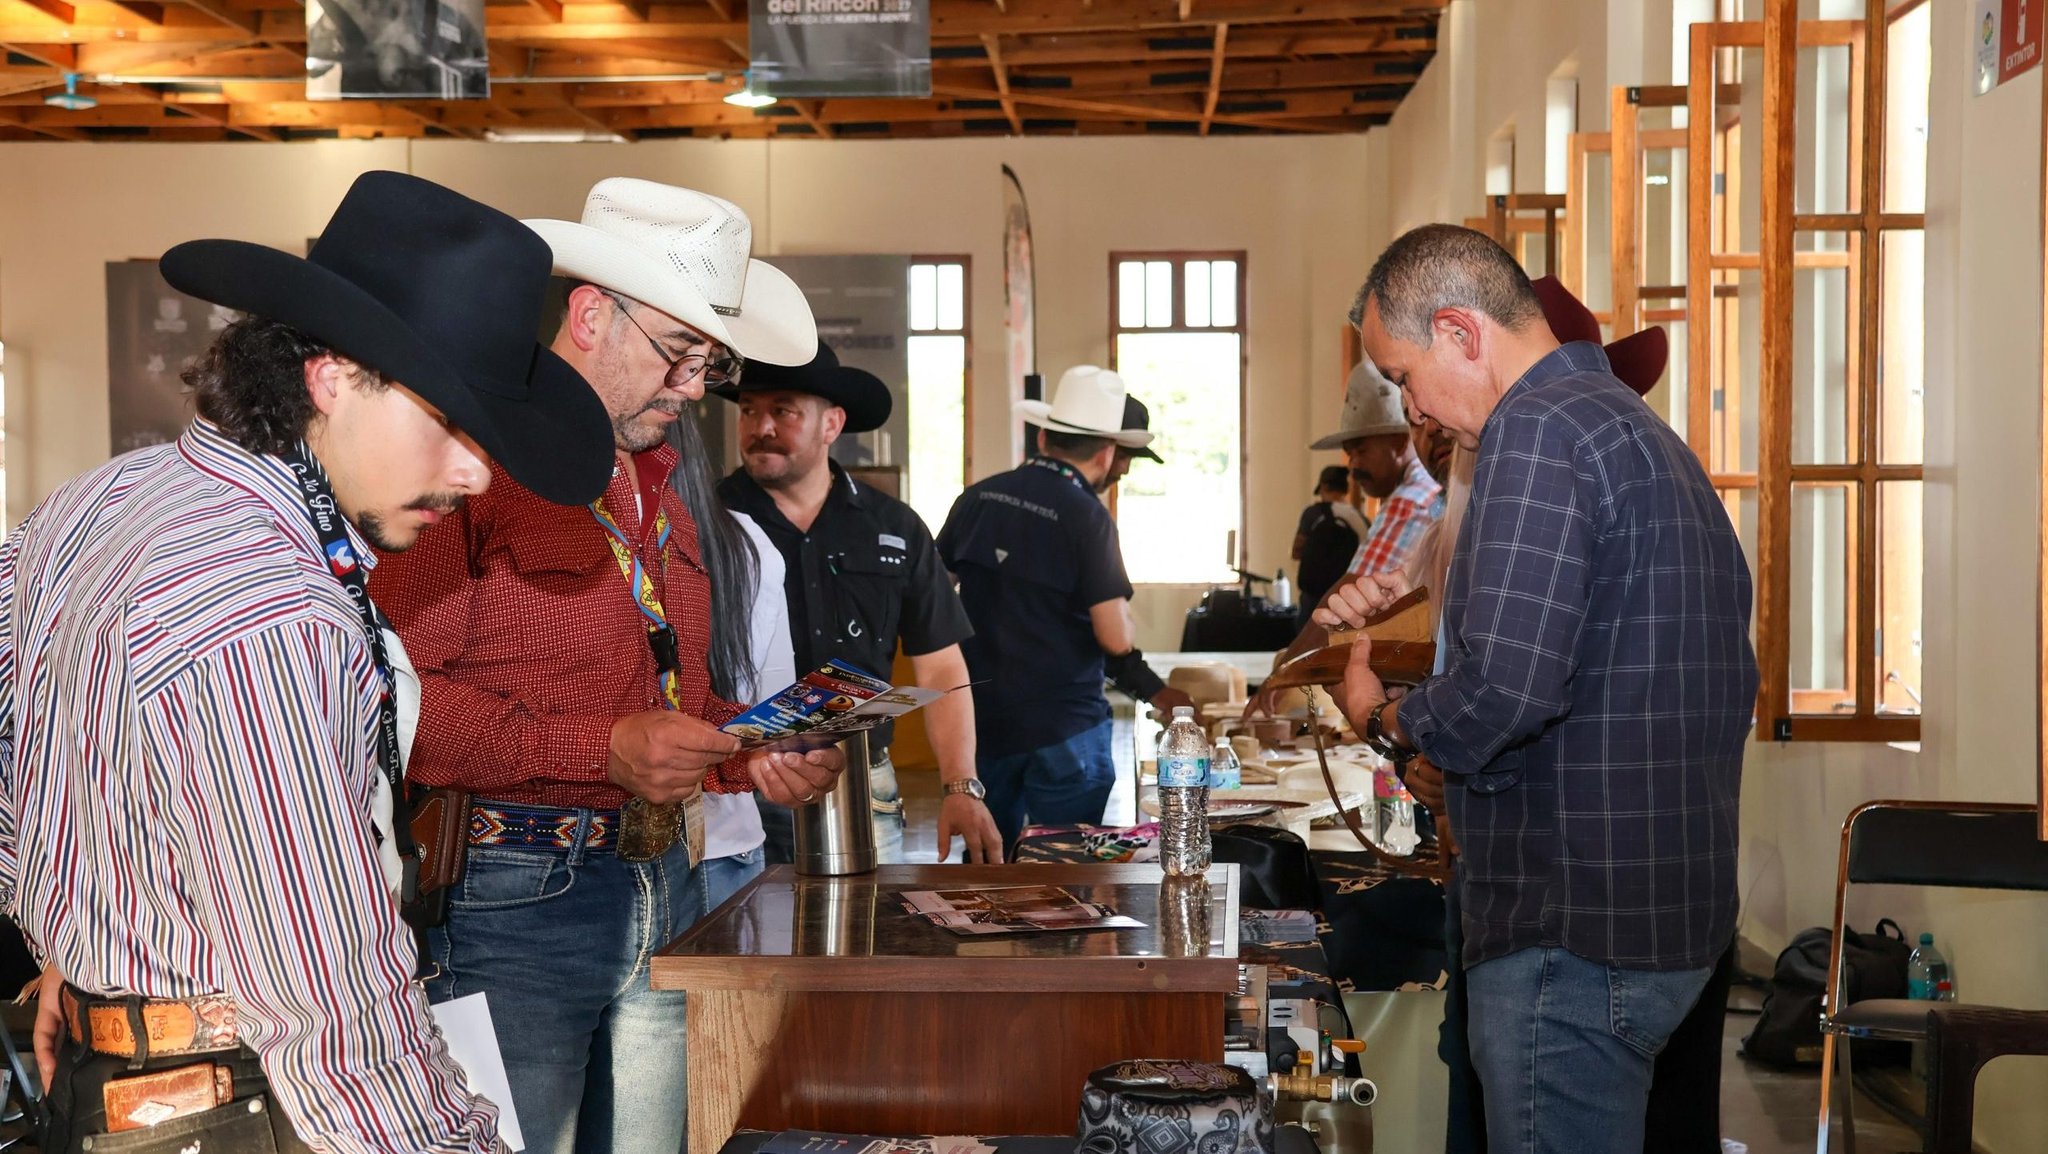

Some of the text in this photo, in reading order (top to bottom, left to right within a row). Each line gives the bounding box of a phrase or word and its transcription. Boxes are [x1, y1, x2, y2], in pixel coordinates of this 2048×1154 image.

[2005, 41, 2036, 72] EXTINTOR
[309, 494, 336, 532] Fino
[382, 710, 399, 784] Gallo Fino
